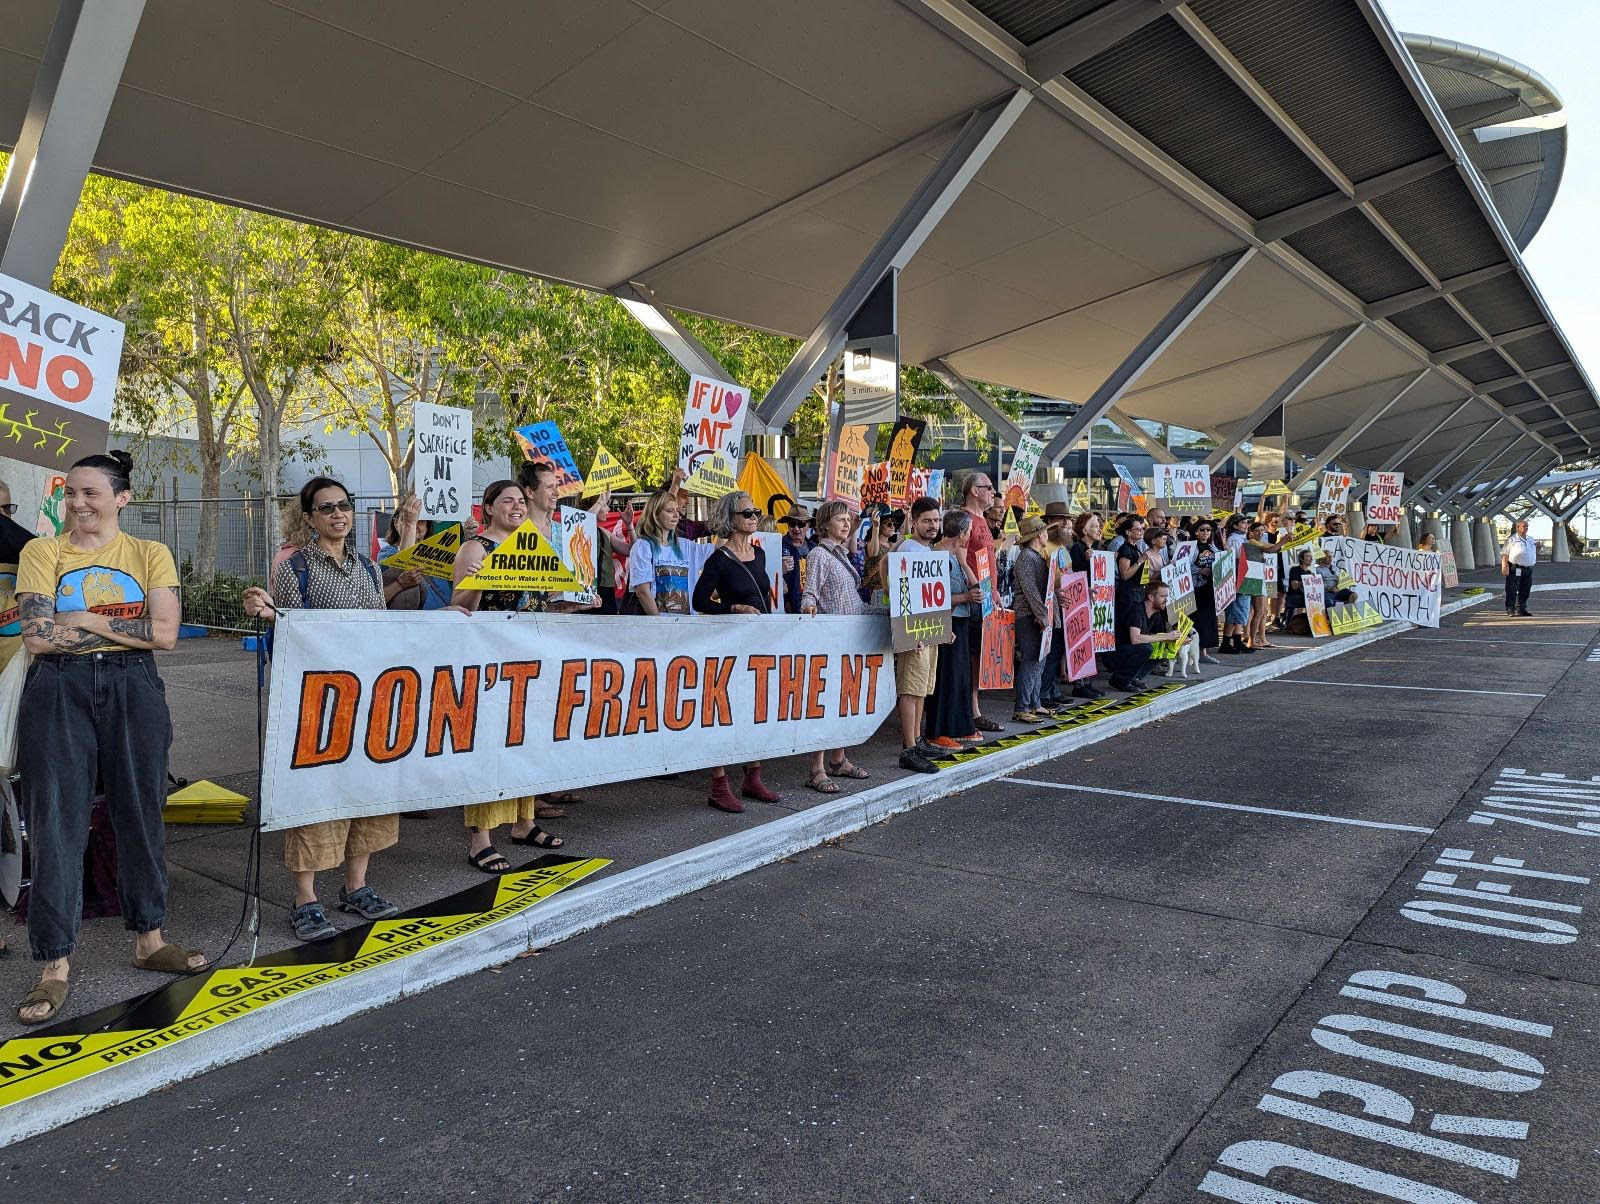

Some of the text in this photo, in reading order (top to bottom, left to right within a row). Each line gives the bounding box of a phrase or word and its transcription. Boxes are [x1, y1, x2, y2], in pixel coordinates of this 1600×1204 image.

[0, 332, 94, 403] NO
[691, 380, 724, 415] IF U
[432, 412, 460, 430] DON'T
[530, 429, 550, 443] NO
[682, 423, 700, 438] SAY
[698, 417, 733, 449] NT
[527, 440, 567, 460] MORE
[599, 452, 610, 466] NO
[682, 444, 694, 459] NO
[726, 441, 738, 459] NO
[840, 450, 865, 467] DON'T
[434, 455, 453, 481] NT
[545, 456, 573, 471] OAL
[712, 456, 725, 471] NO
[891, 458, 909, 470] DON'T
[1014, 459, 1033, 479] SOLAR
[557, 470, 582, 487] AS
[591, 465, 622, 481] FRACKING
[699, 468, 736, 489] FRACKING
[838, 465, 858, 482] FRAC
[868, 468, 882, 483] NO
[1175, 469, 1204, 479] FRACK
[1325, 474, 1343, 487] IF U
[1378, 474, 1395, 484] THE
[836, 480, 850, 495] THE
[860, 481, 891, 498] CARBON
[898, 485, 905, 498] NT
[1184, 481, 1206, 495] NO
[1214, 488, 1235, 499] RAELI
[1371, 484, 1400, 496] FUTURE
[423, 486, 459, 516] GAS
[863, 494, 889, 508] BOMB
[1319, 501, 1333, 511] SAY
[1381, 496, 1390, 505] IS
[564, 512, 587, 532] STOP
[1368, 506, 1401, 521] SOLAR
[437, 531, 457, 547] NO
[516, 531, 539, 551] NO
[411, 543, 456, 565] FRACKING
[491, 553, 560, 572] FRACKING
[1363, 543, 1440, 571] EXPANSION
[475, 573, 502, 581] Protect
[911, 560, 943, 578] FRACK
[1093, 556, 1107, 581] NO
[1354, 562, 1437, 593] DESTROYING
[1178, 576, 1190, 594] NO
[921, 581, 945, 608] NO
[102, 606, 139, 617] FREE NT
[1368, 590, 1430, 621] NORTH
[1073, 645, 1087, 670] ARM
[290, 653, 885, 770] DON'T FRACK THE NT
[502, 868, 560, 893] LINE
[1400, 847, 1591, 945] OFF
[371, 918, 442, 944] PIPE
[100, 892, 542, 1063] PROTECT NT WATER, COUNTRY & COMMUNITY
[209, 968, 288, 998] GAS
[0, 1041, 83, 1079] NO
